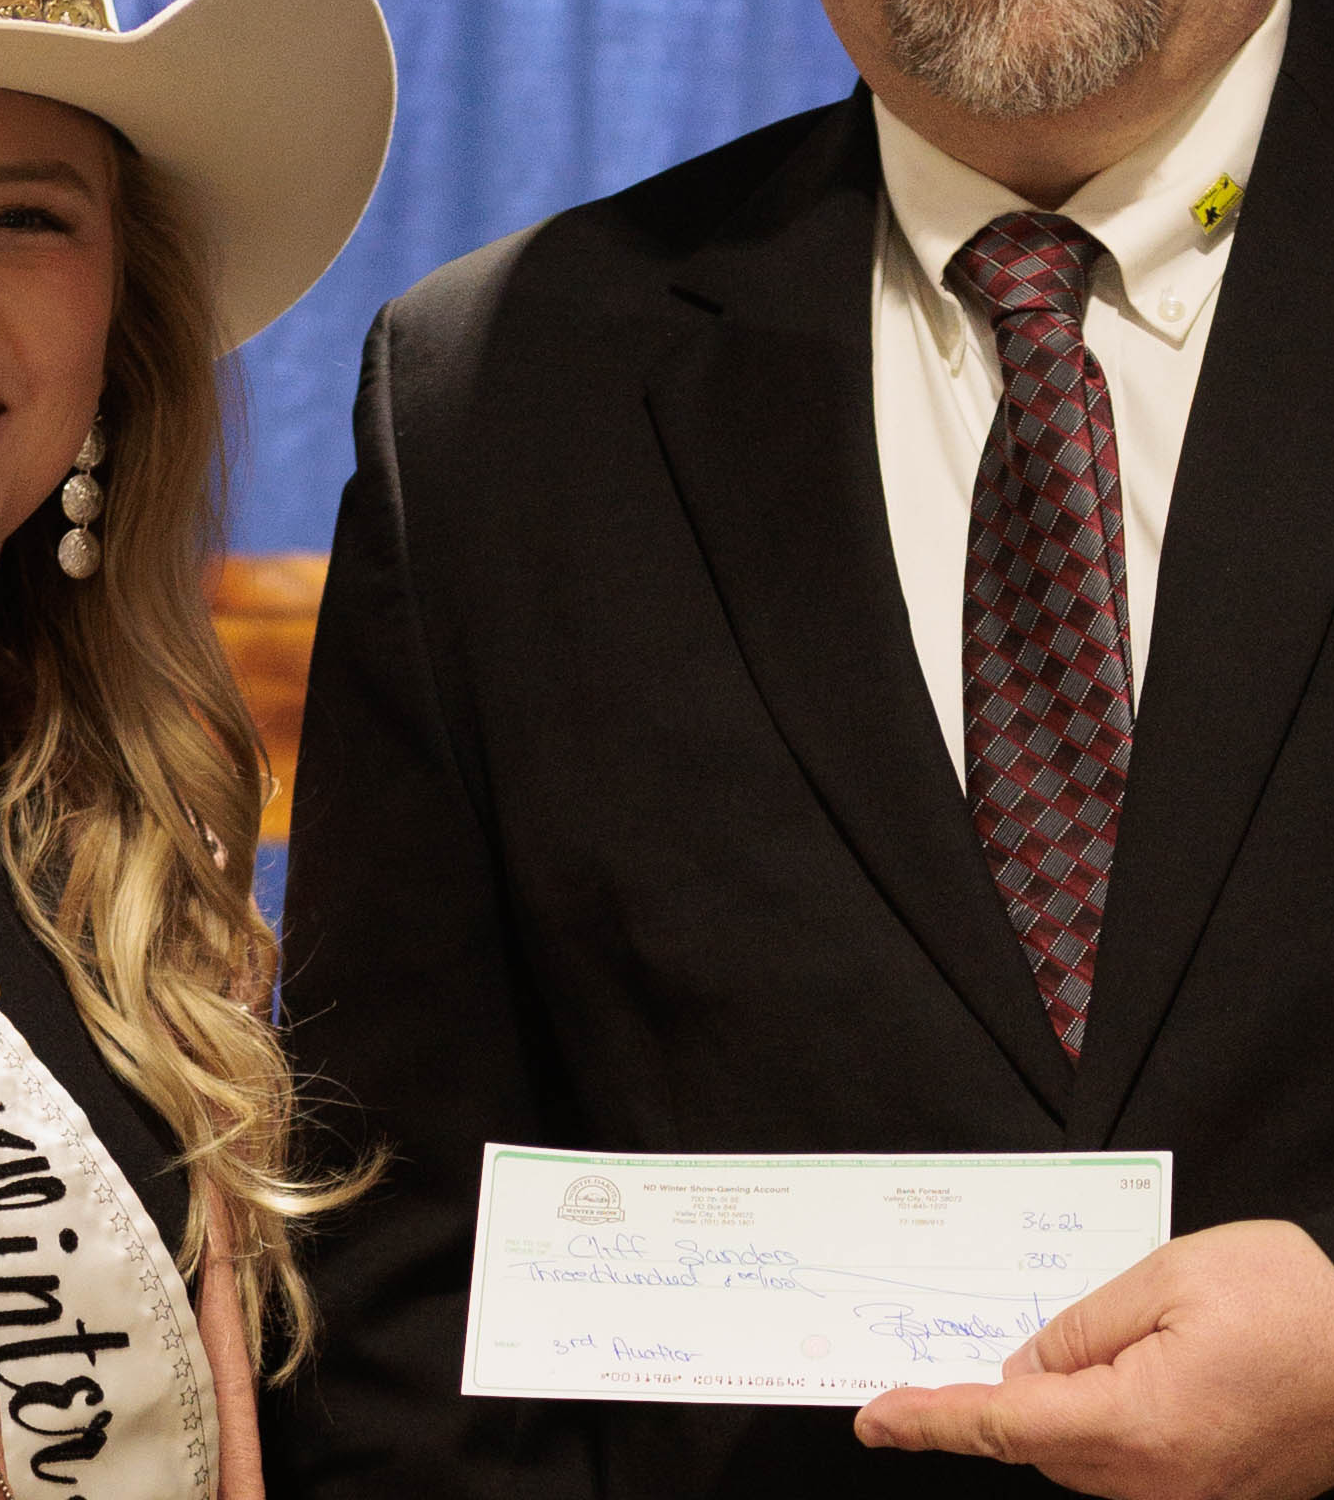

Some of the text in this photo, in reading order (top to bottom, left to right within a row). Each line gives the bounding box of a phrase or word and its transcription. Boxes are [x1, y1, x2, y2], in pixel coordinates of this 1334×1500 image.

[643, 1184, 657, 1192] ND
[660, 1184, 687, 1193] Winter
[753, 1185, 790, 1194] Account
[1120, 1179, 1151, 1189] 3198
[567, 1233, 799, 1266] Cliff Sanders
[553, 1334, 598, 1355] 3rd
